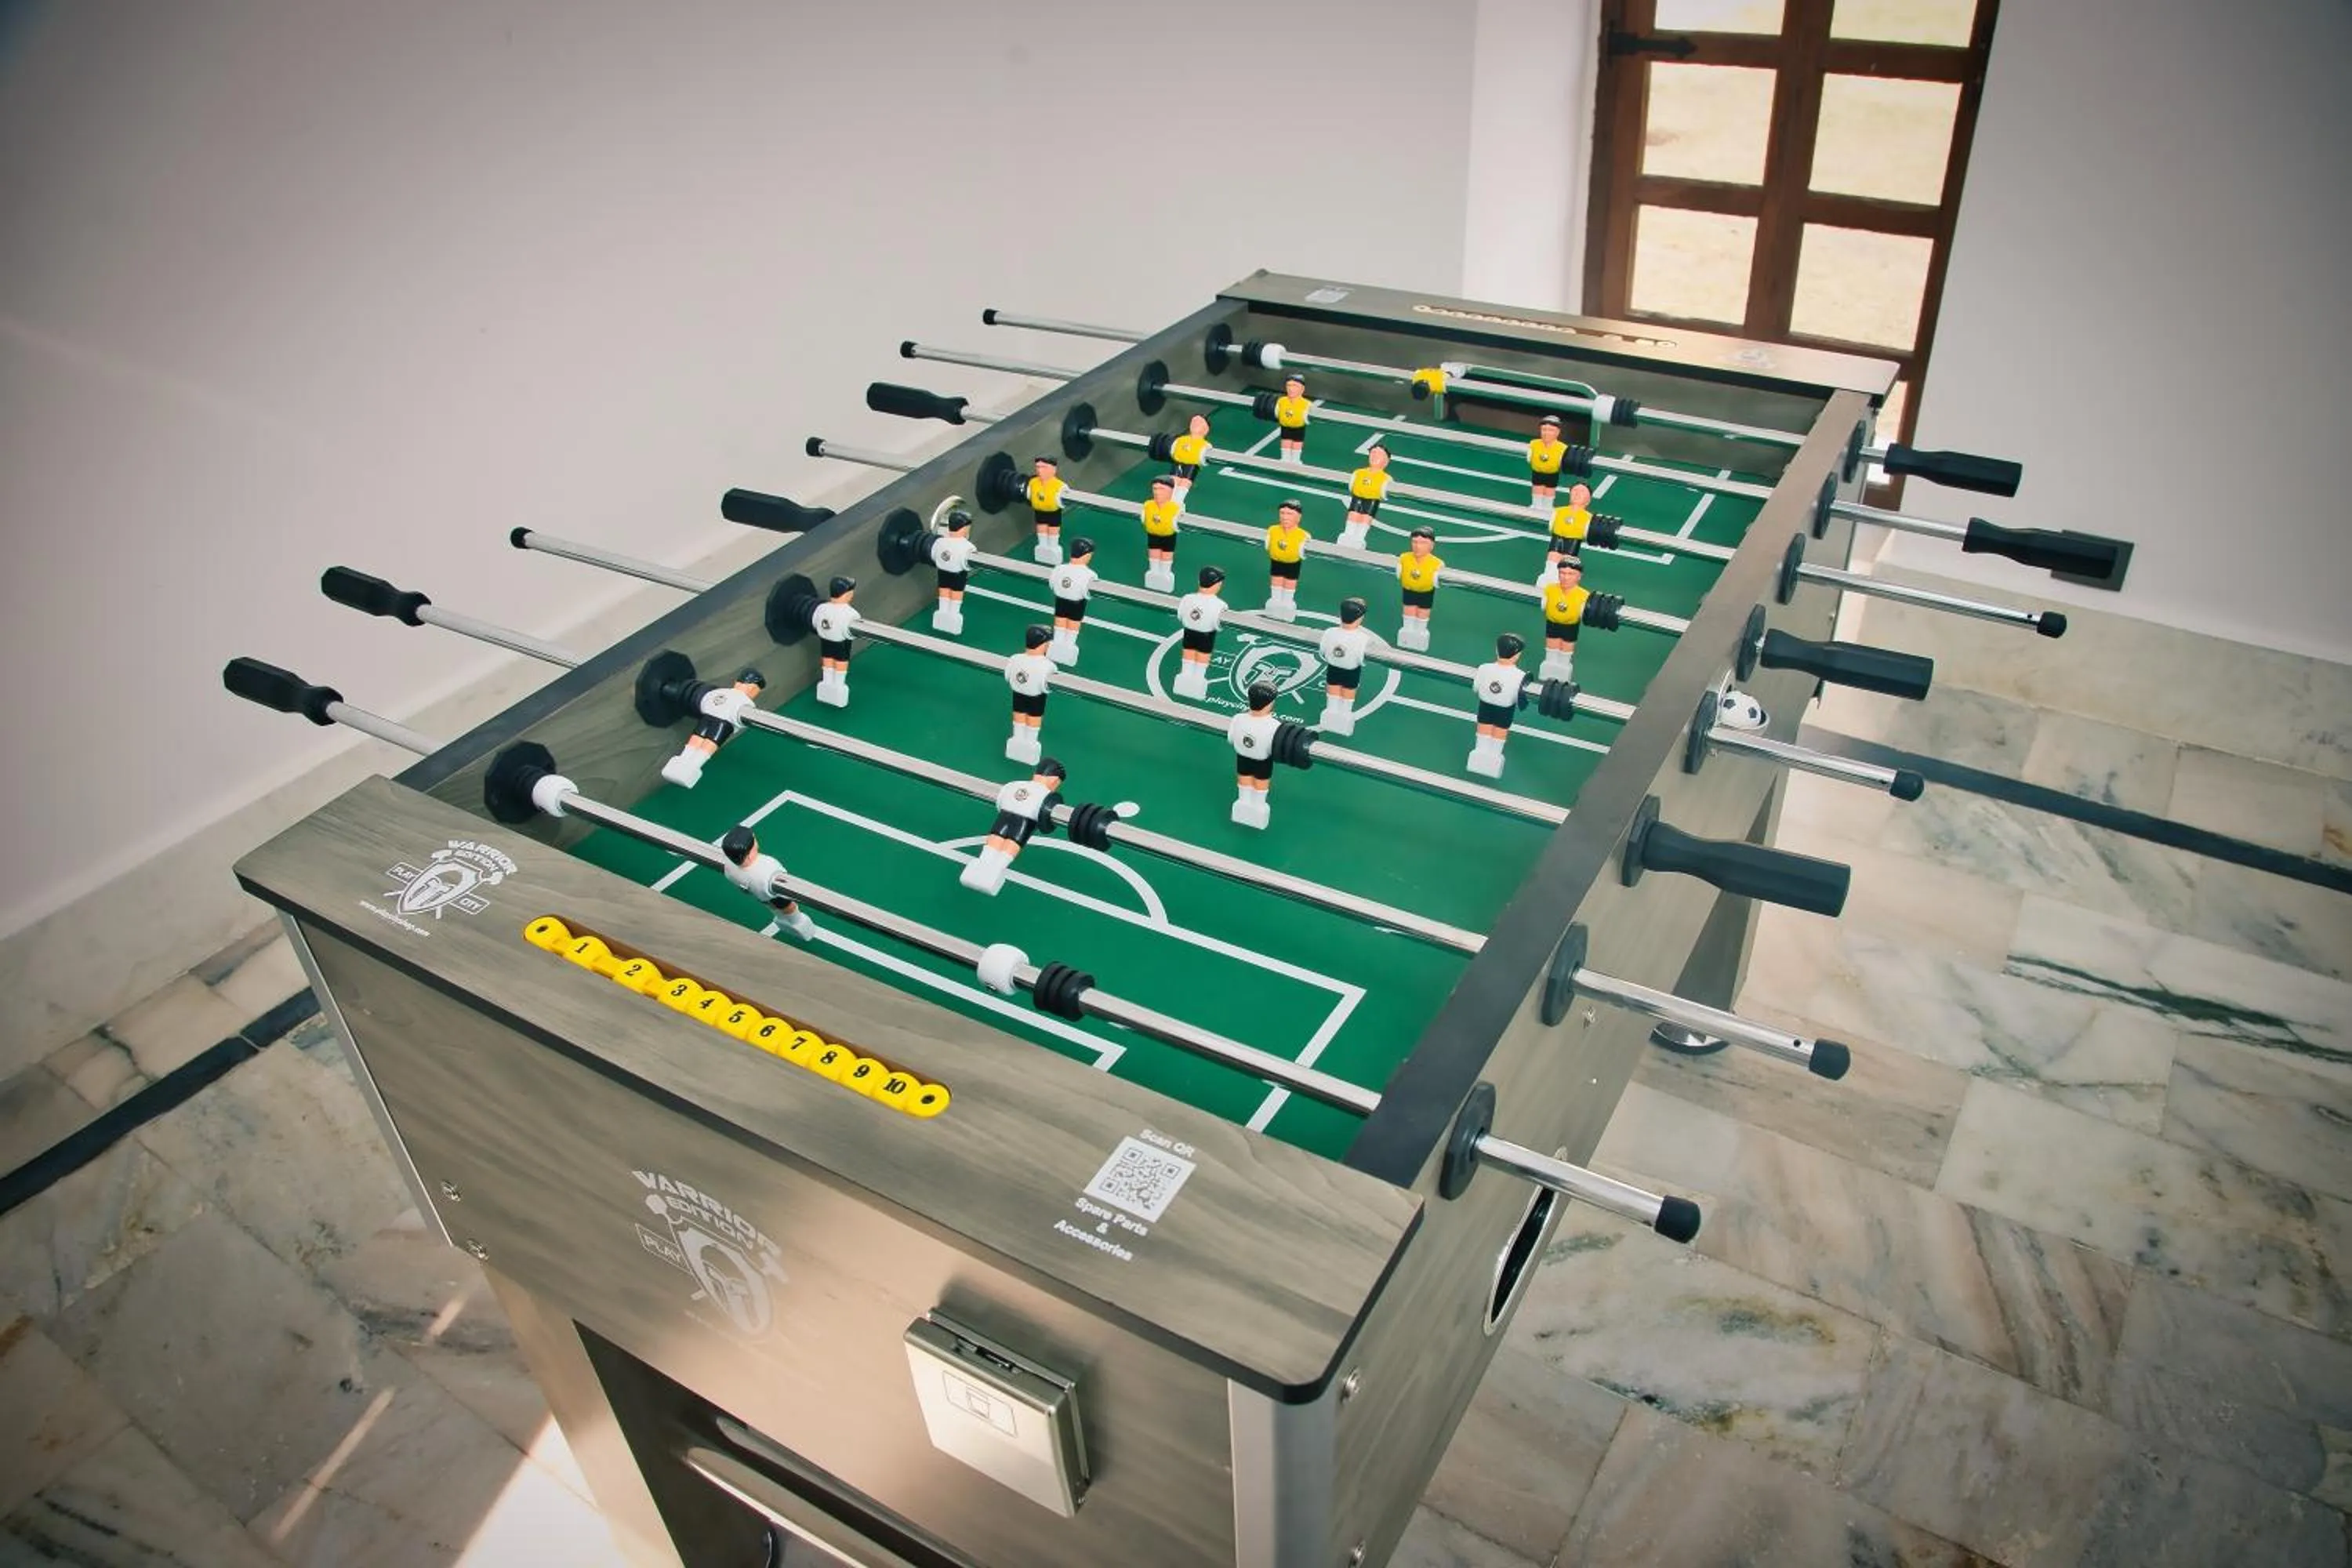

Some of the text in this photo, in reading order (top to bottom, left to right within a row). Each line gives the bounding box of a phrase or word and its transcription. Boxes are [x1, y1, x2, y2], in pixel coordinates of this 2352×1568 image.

[448, 840, 517, 876] WARRIOR
[575, 943, 908, 1094] 1 2 3 4 5 6 7 8 9 10
[1140, 1129, 1195, 1158] Scan QR
[632, 1170, 782, 1258] WARRIOR
[665, 1196, 754, 1250] EDITION
[1075, 1196, 1149, 1236] Spare Parts
[1096, 1221, 1109, 1235] &
[1053, 1219, 1134, 1262] Accessories
